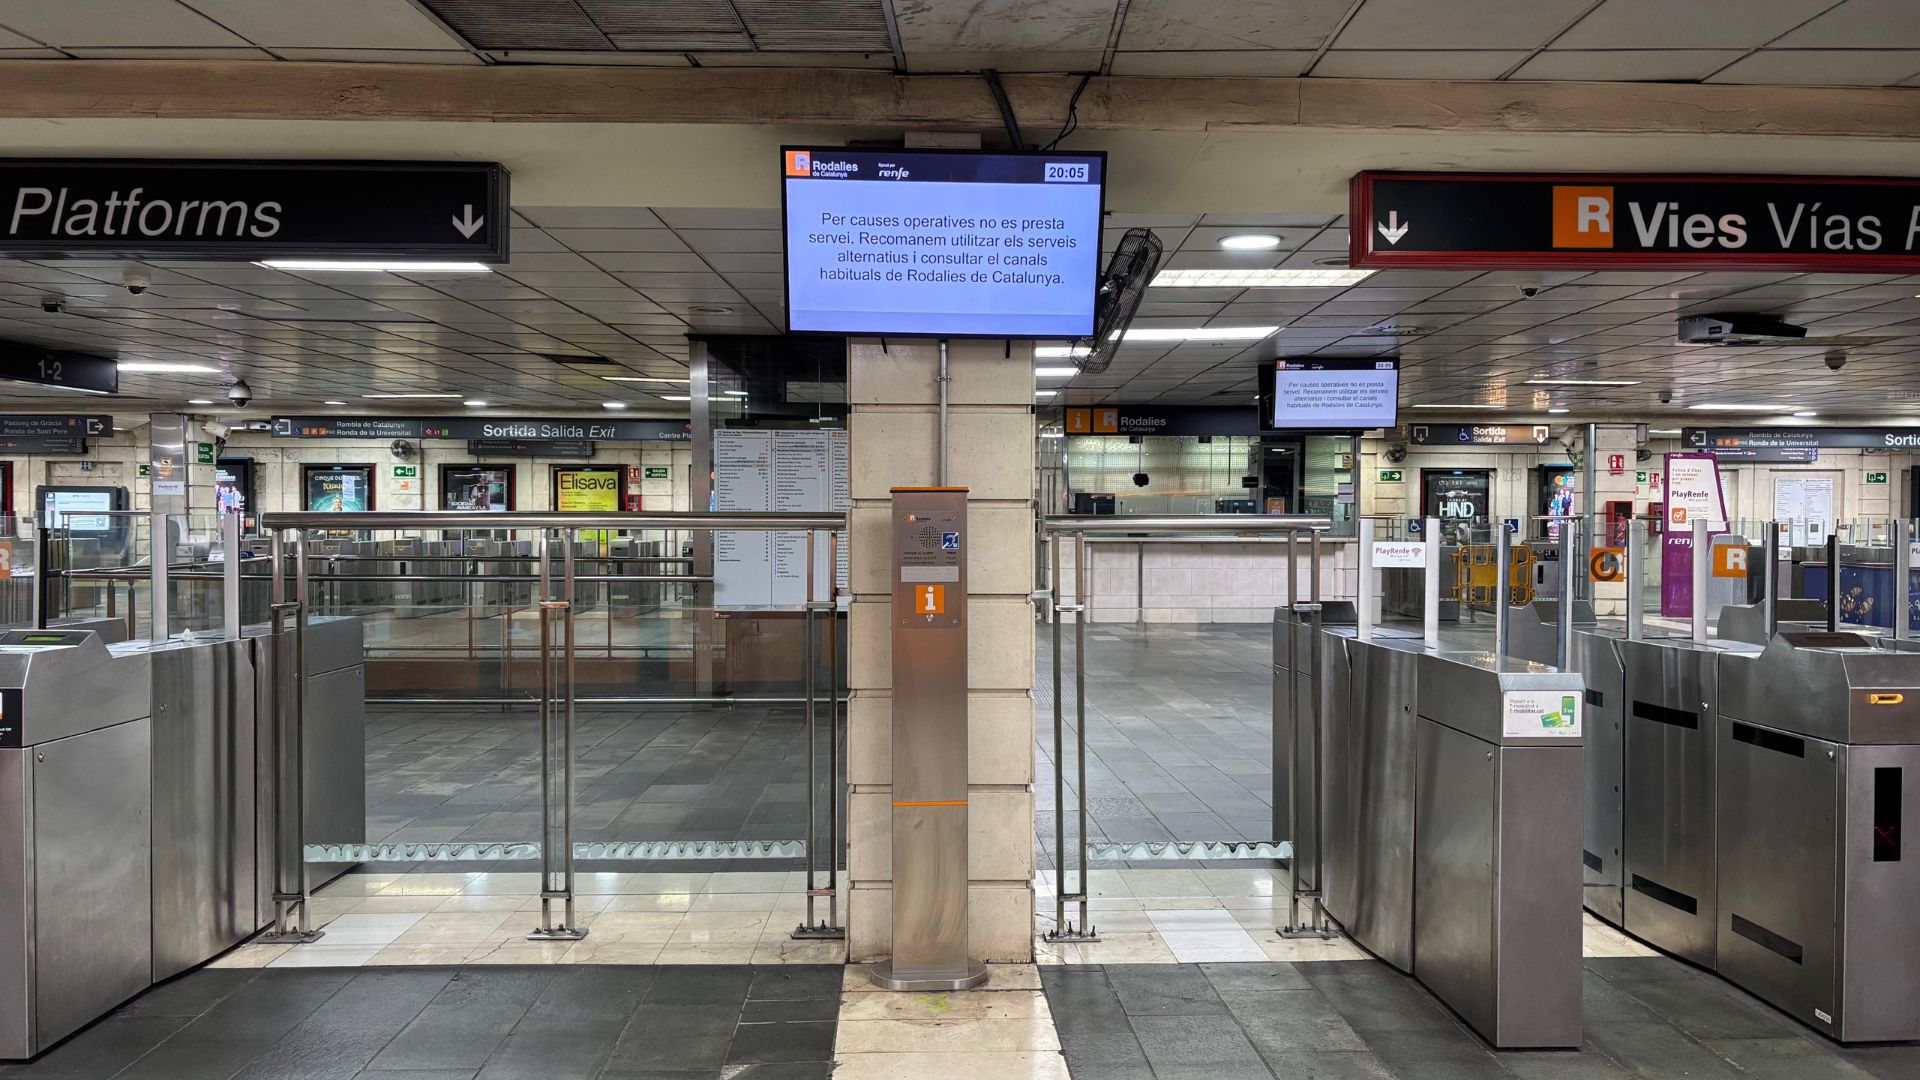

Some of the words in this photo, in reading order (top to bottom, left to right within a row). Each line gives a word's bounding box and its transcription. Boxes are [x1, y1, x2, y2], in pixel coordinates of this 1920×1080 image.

[812, 161, 858, 172] Rodalies
[879, 168, 910, 180] renfe
[1049, 167, 1084, 179] 20:05
[9, 187, 282, 238] Platforms
[1577, 196, 1610, 232] R
[822, 212, 846, 226] Per
[850, 215, 898, 228] causes
[904, 215, 975, 231] operatives
[980, 217, 996, 229] no
[1001, 218, 1017, 230] es
[1022, 218, 1064, 232] presta
[1628, 202, 1748, 248] Vies
[1767, 202, 1883, 250] Vías
[809, 232, 854, 244] servei.
[859, 232, 946, 246] Recomanem
[951, 234, 1000, 248] utilitzar
[1004, 234, 1024, 248] els
[1028, 235, 1076, 248] serveis
[838, 250, 908, 264] alternatius
[921, 251, 983, 265] consultar
[988, 252, 999, 265] el
[1004, 252, 1048, 266] canals
[820, 268, 880, 282] habituals
[886, 268, 902, 282] de
[908, 270, 966, 283] Rodalies
[971, 270, 988, 283] de
[992, 270, 1064, 286] Catalunya.
[38, 360, 62, 380] 1-2
[1121, 416, 1166, 426] Rodalies
[483, 424, 536, 437] Sortida
[541, 425, 584, 438] Salida
[589, 426, 616, 438] Exit
[1473, 427, 1506, 436] Sortida
[560, 474, 616, 490] Elisava
[1672, 490, 1709, 499] PlayRenfe
[1440, 502, 1474, 517] HIND
